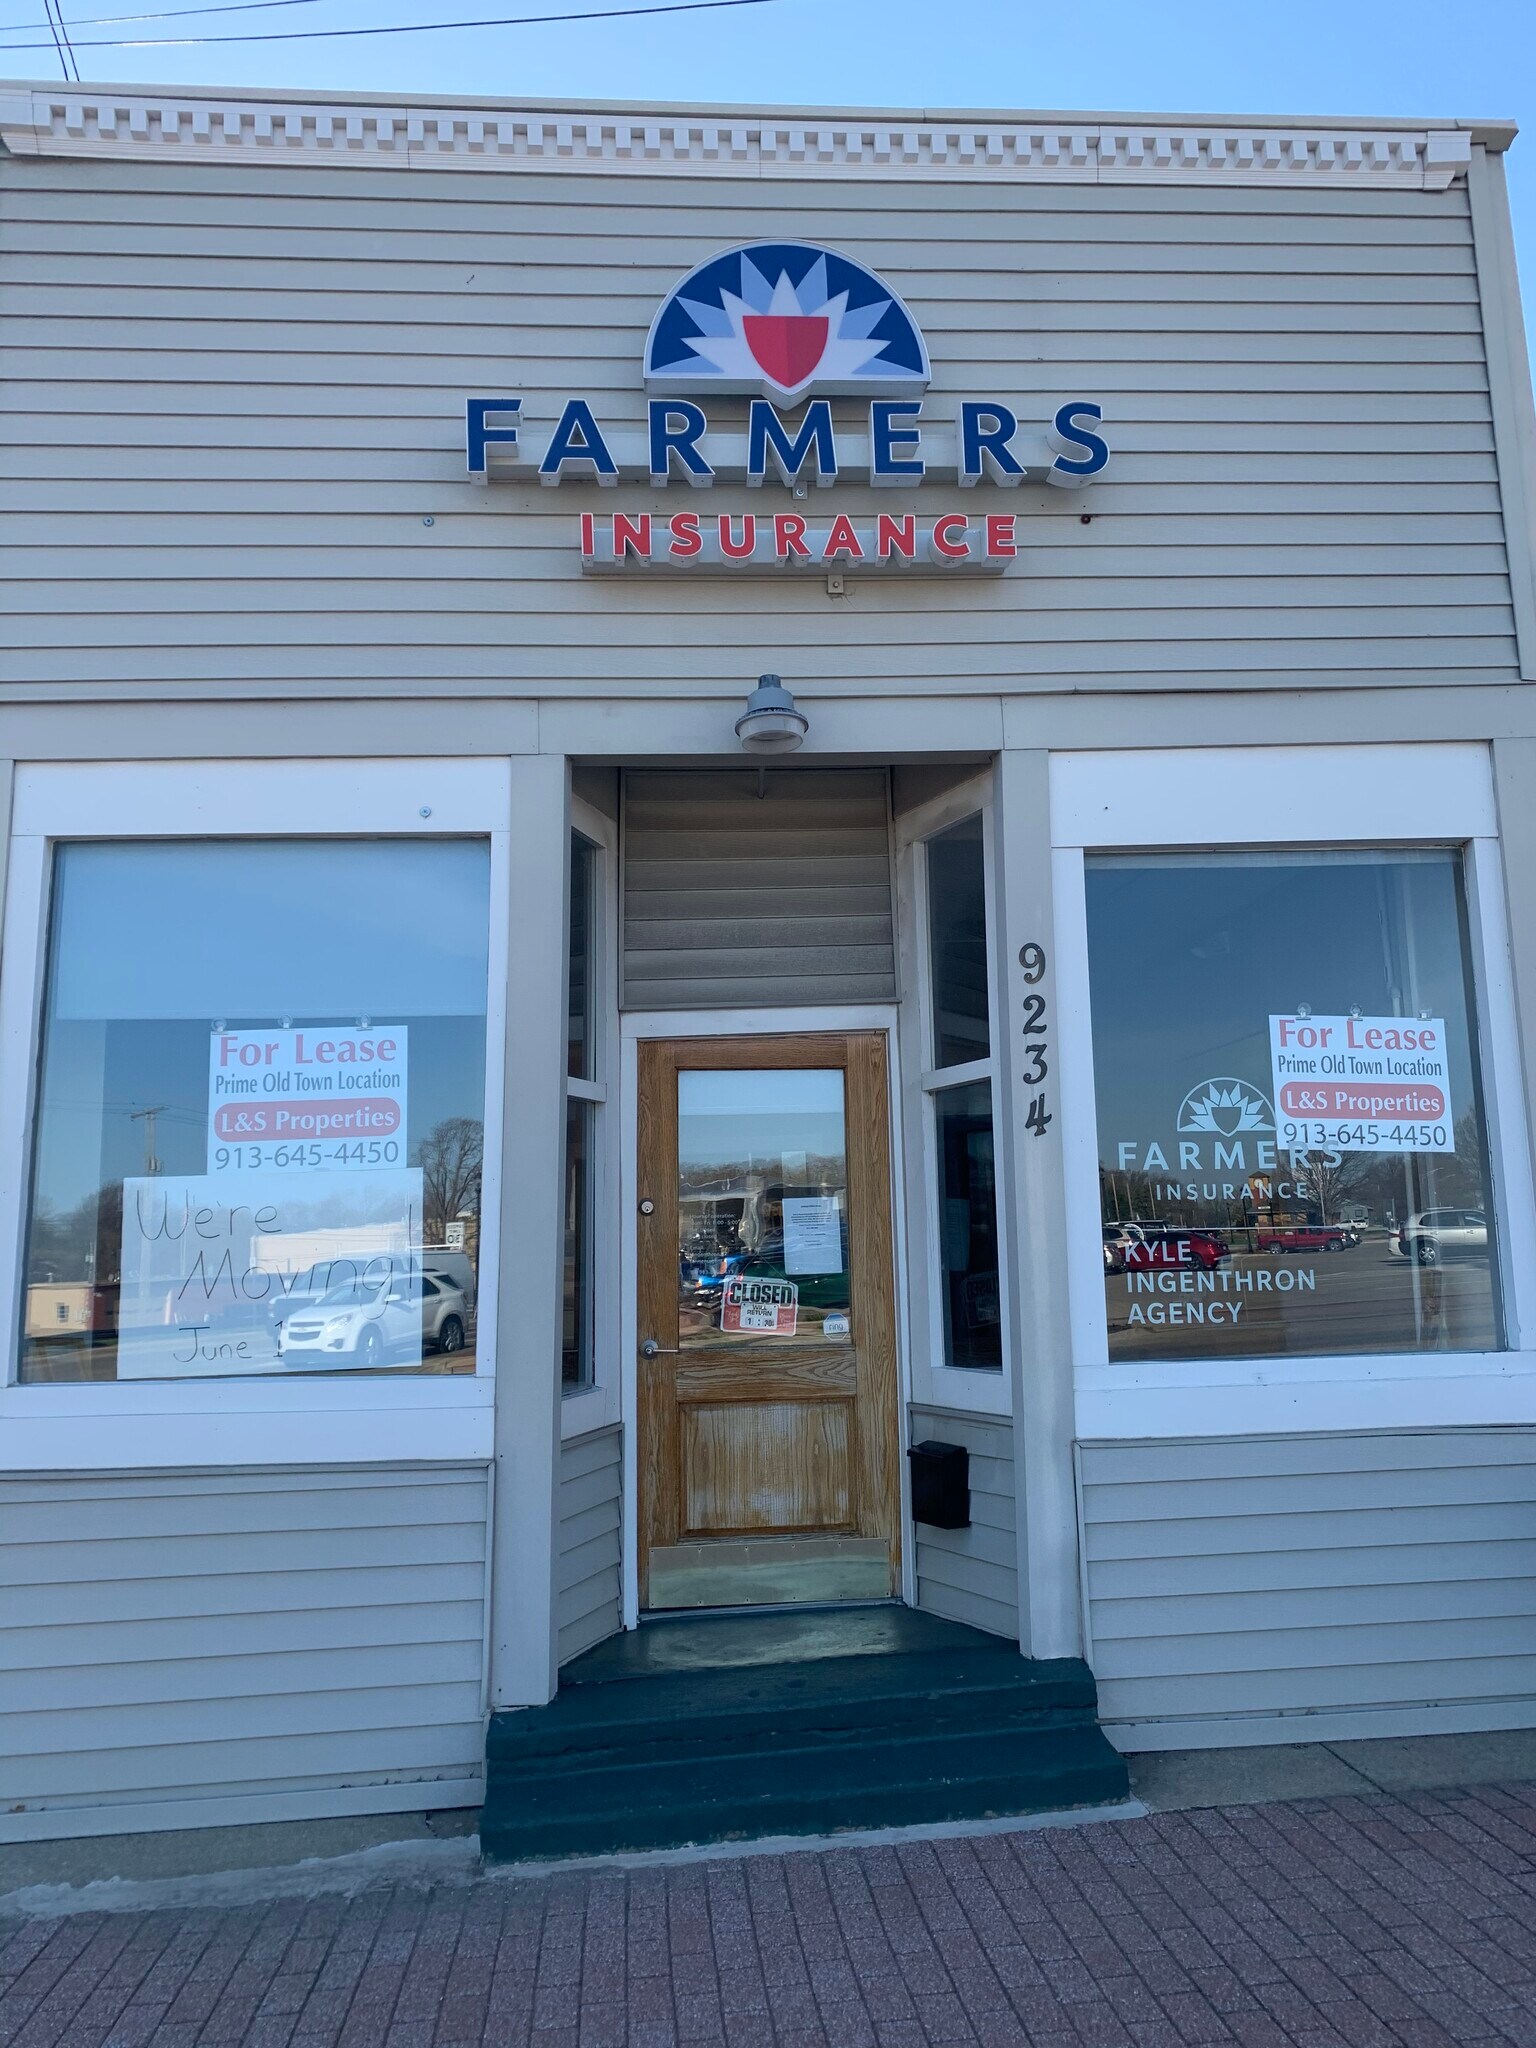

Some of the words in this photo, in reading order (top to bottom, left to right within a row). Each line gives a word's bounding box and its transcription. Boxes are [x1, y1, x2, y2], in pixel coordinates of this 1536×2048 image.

[466, 398, 1110, 480] FARMERS
[580, 511, 1018, 558] INSURANCE
[1018, 942, 1052, 1137] 9234
[1279, 1019, 1332, 1048] For
[1346, 1020, 1436, 1050] Lease
[220, 1036, 279, 1067] For
[295, 1034, 397, 1064] Lease
[1278, 1054, 1316, 1074] Prime
[1321, 1055, 1346, 1074] Old
[1348, 1057, 1382, 1074] Town
[1387, 1057, 1442, 1076] Location
[215, 1073, 257, 1094] Prime
[263, 1071, 290, 1092] Old
[294, 1072, 332, 1091] Town
[338, 1068, 400, 1090] Location
[1286, 1090, 1328, 1110] L&S
[1335, 1092, 1440, 1116] Properties
[221, 1111, 267, 1132] L&S
[275, 1106, 395, 1136] Properties
[1283, 1123, 1447, 1146] 913-645-4450
[215, 1141, 399, 1170] 913-645-4450
[1118, 1140, 1343, 1171] FARMERS
[1156, 1182, 1308, 1200] INSURANCE
[1125, 1240, 1193, 1263] KYLE
[1126, 1269, 1316, 1293] INGENTHRON
[730, 1283, 793, 1307] CLOSED
[1127, 1302, 1243, 1325] AGENCY
[829, 1323, 844, 1331] ring
[173, 1326, 252, 1362] June
